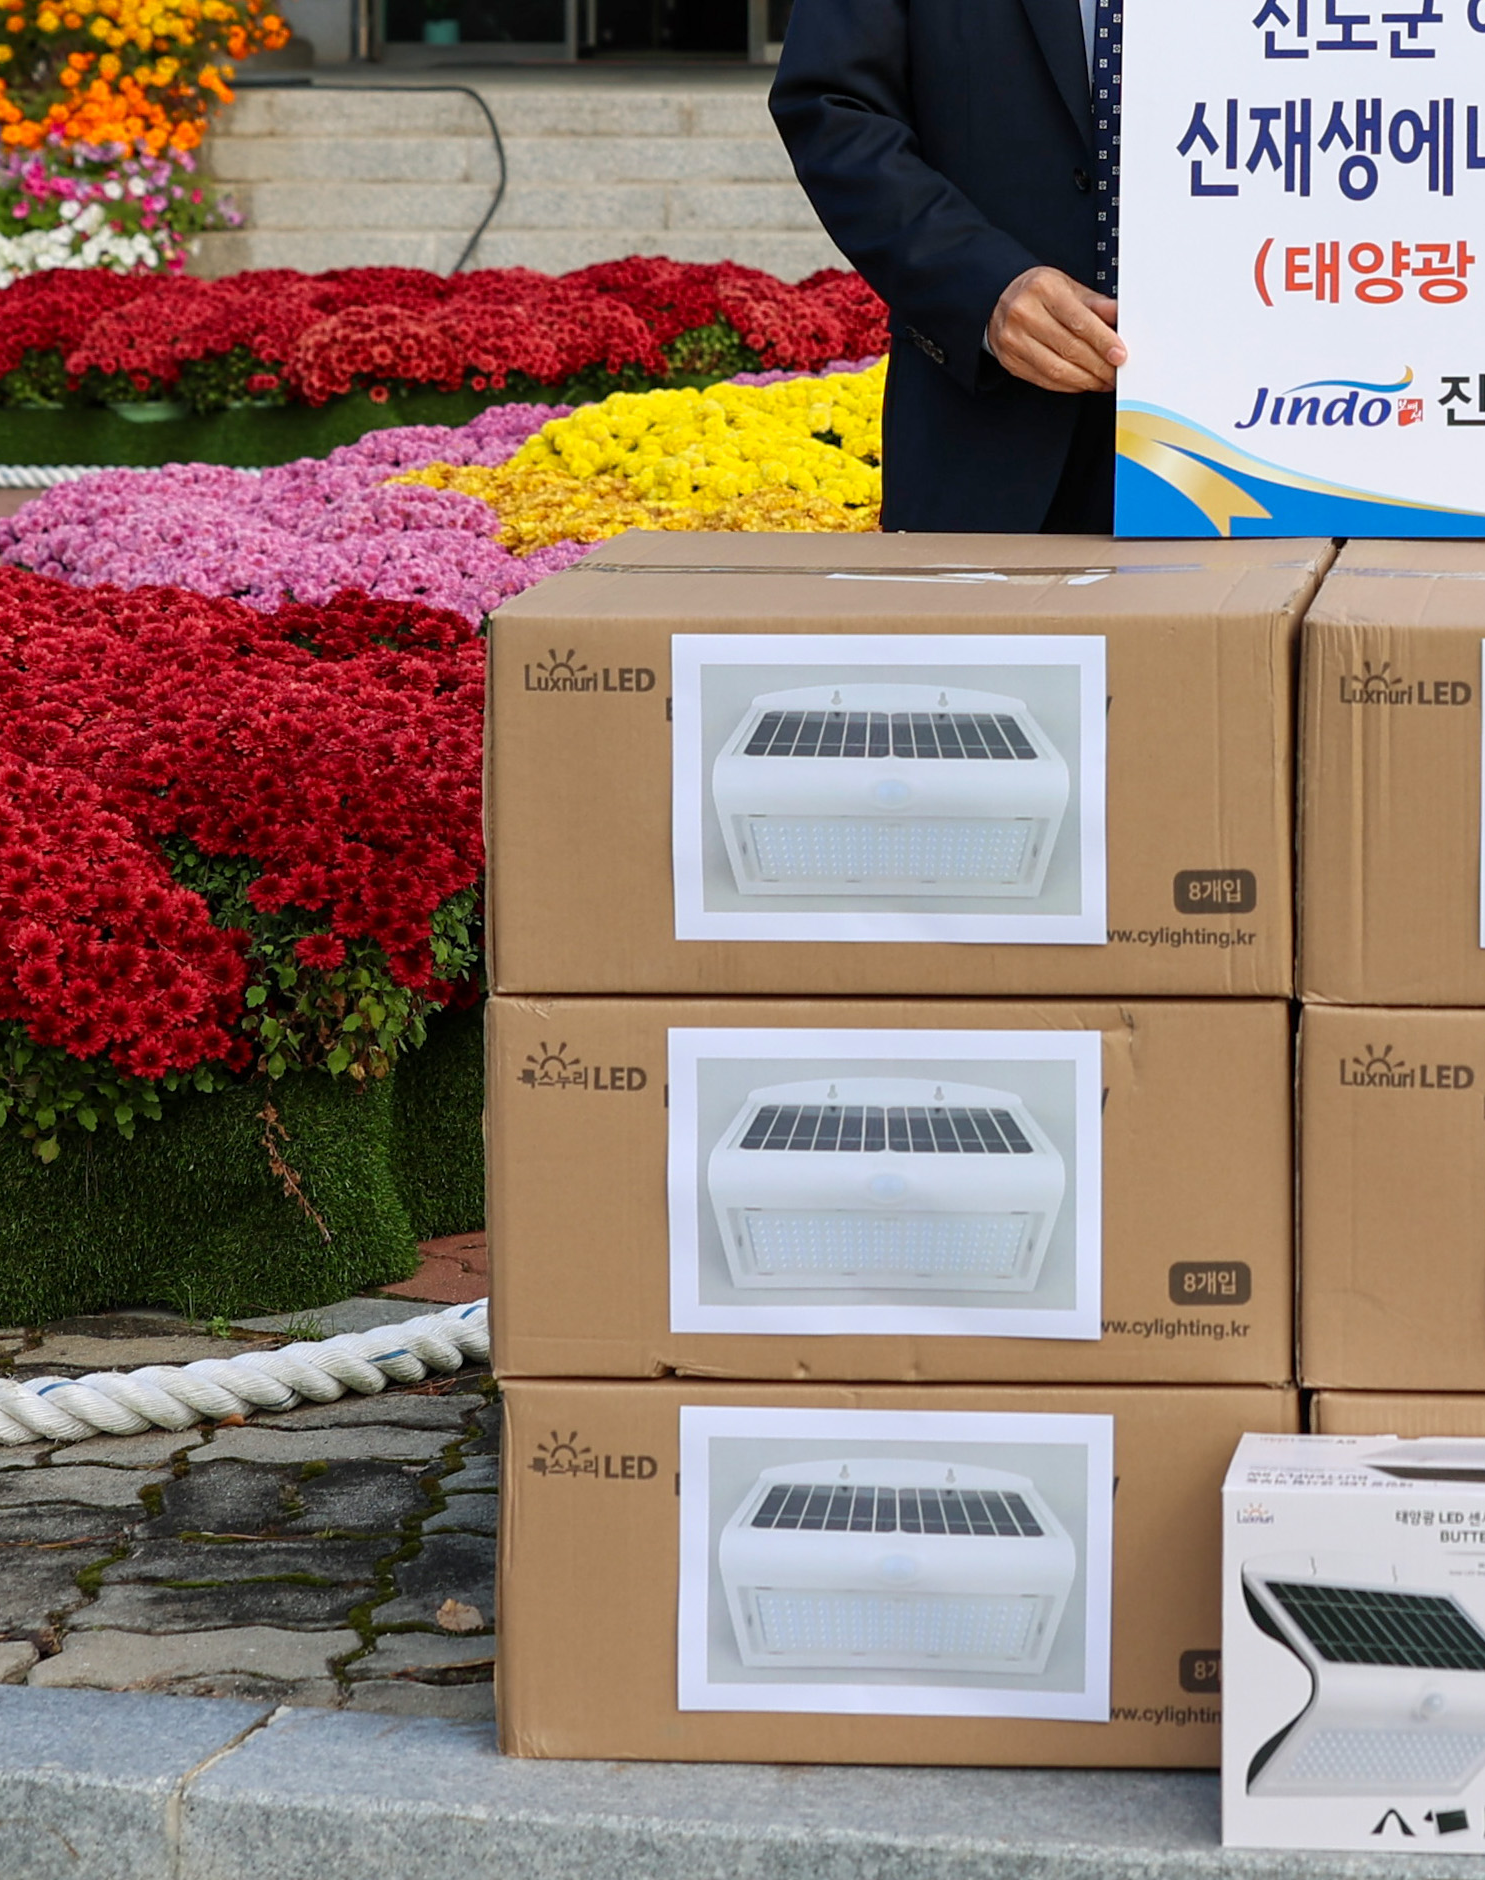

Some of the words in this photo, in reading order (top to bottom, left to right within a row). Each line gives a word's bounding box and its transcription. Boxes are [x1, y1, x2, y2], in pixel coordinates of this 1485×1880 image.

[1251, 237, 1474, 307] (태양광
[1234, 387, 1392, 430] Jindo
[524, 663, 598, 693] Luxnuri
[602, 667, 657, 693] LED
[1339, 675, 1413, 706] Luxnuri
[1417, 681, 1472, 706] LED
[1187, 878, 1243, 906] 8개입
[593, 1066, 648, 1091] LED
[1339, 1058, 1415, 1088] Luxnuri
[1419, 1064, 1475, 1089] LED
[1181, 1270, 1238, 1298] 8개입
[604, 1455, 658, 1480] LED
[1395, 1510, 1436, 1527] 태양광
[1438, 1512, 1464, 1525] LED
